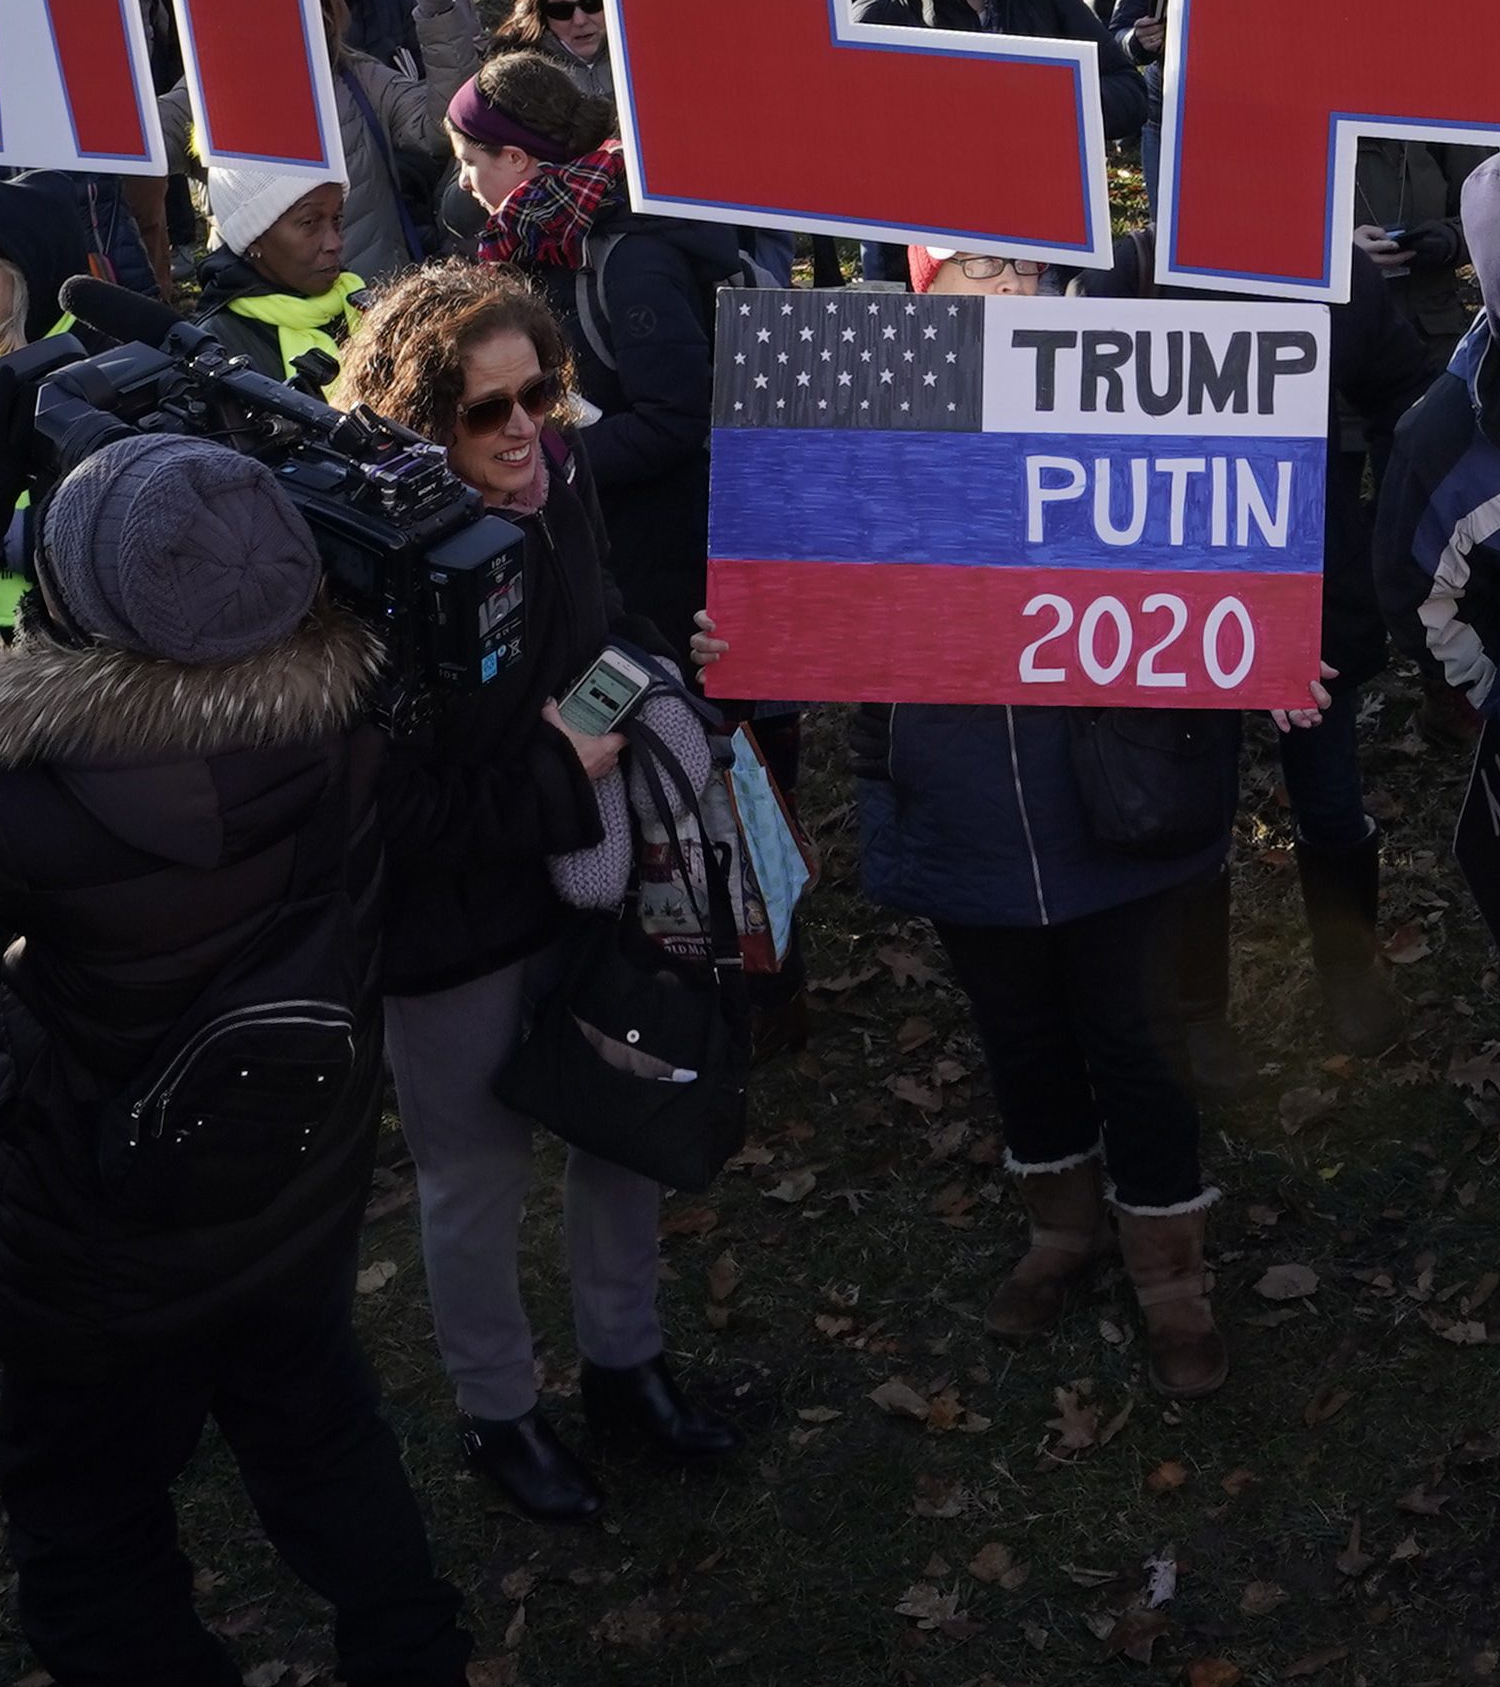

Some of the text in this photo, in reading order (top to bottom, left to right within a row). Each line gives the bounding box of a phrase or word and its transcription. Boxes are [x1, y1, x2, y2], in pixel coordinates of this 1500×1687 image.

[1011, 328, 1318, 416] TRUMP
[1025, 455, 1293, 549] PUTIN
[1018, 593, 1256, 690] 2020
